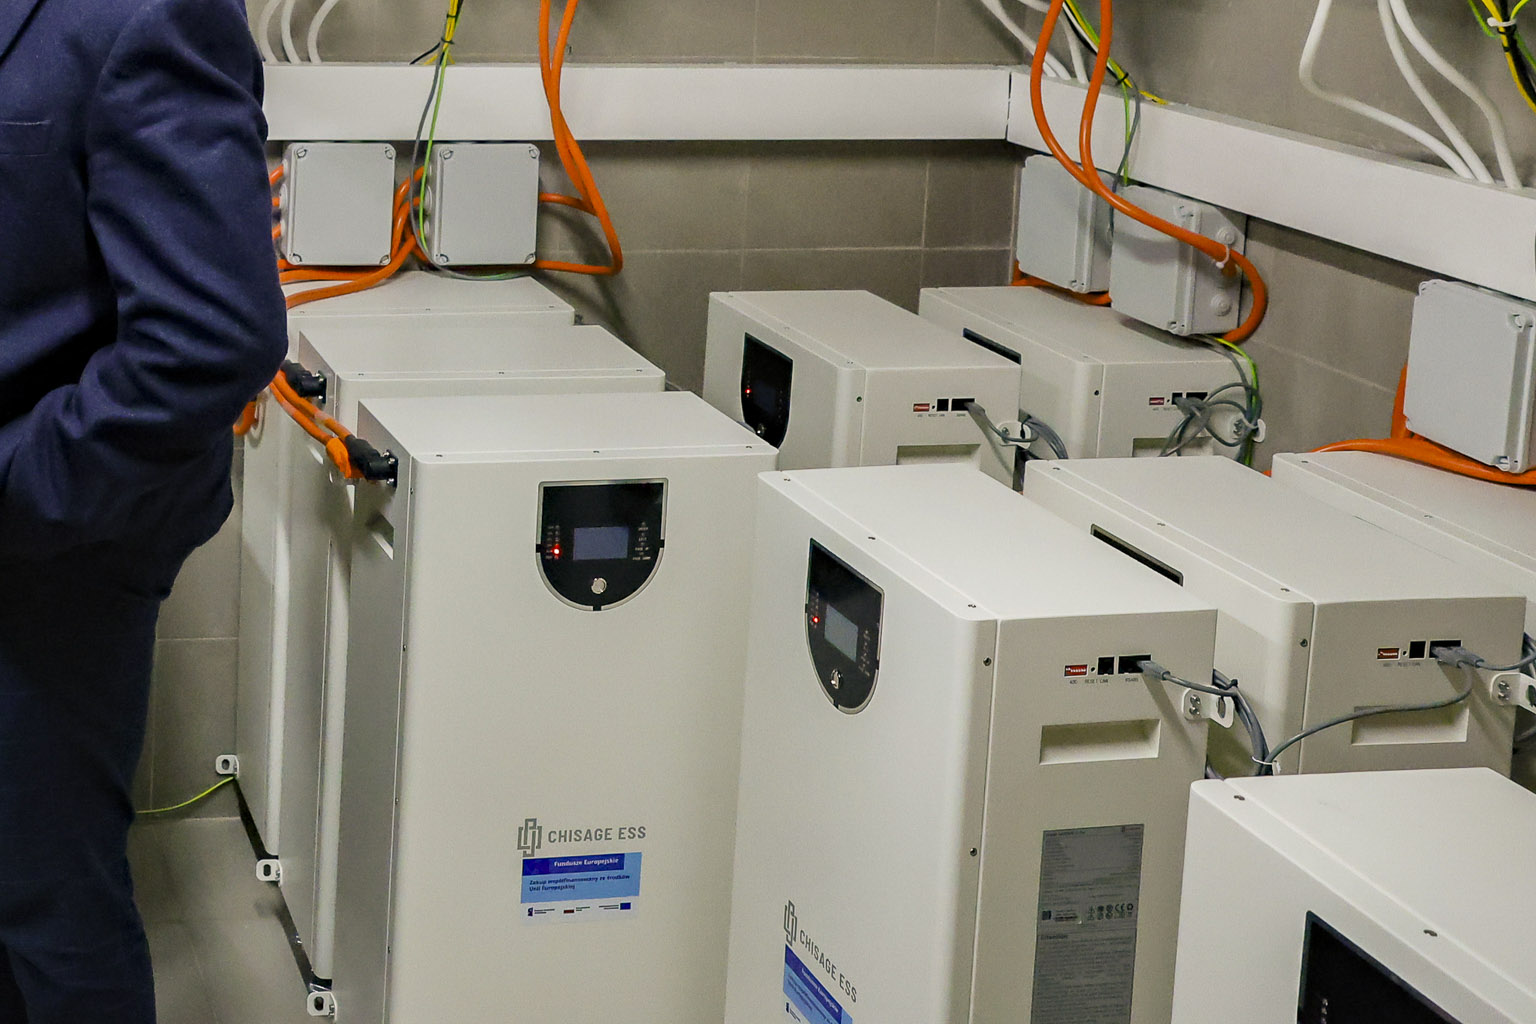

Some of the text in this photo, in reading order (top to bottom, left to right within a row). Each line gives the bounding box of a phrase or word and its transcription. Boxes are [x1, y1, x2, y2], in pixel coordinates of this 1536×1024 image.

[548, 826, 647, 843] CHISAGE ESS
[584, 857, 619, 865] Europejskie
[799, 929, 837, 981] CHISAGE
[839, 973, 857, 1003] ESS
